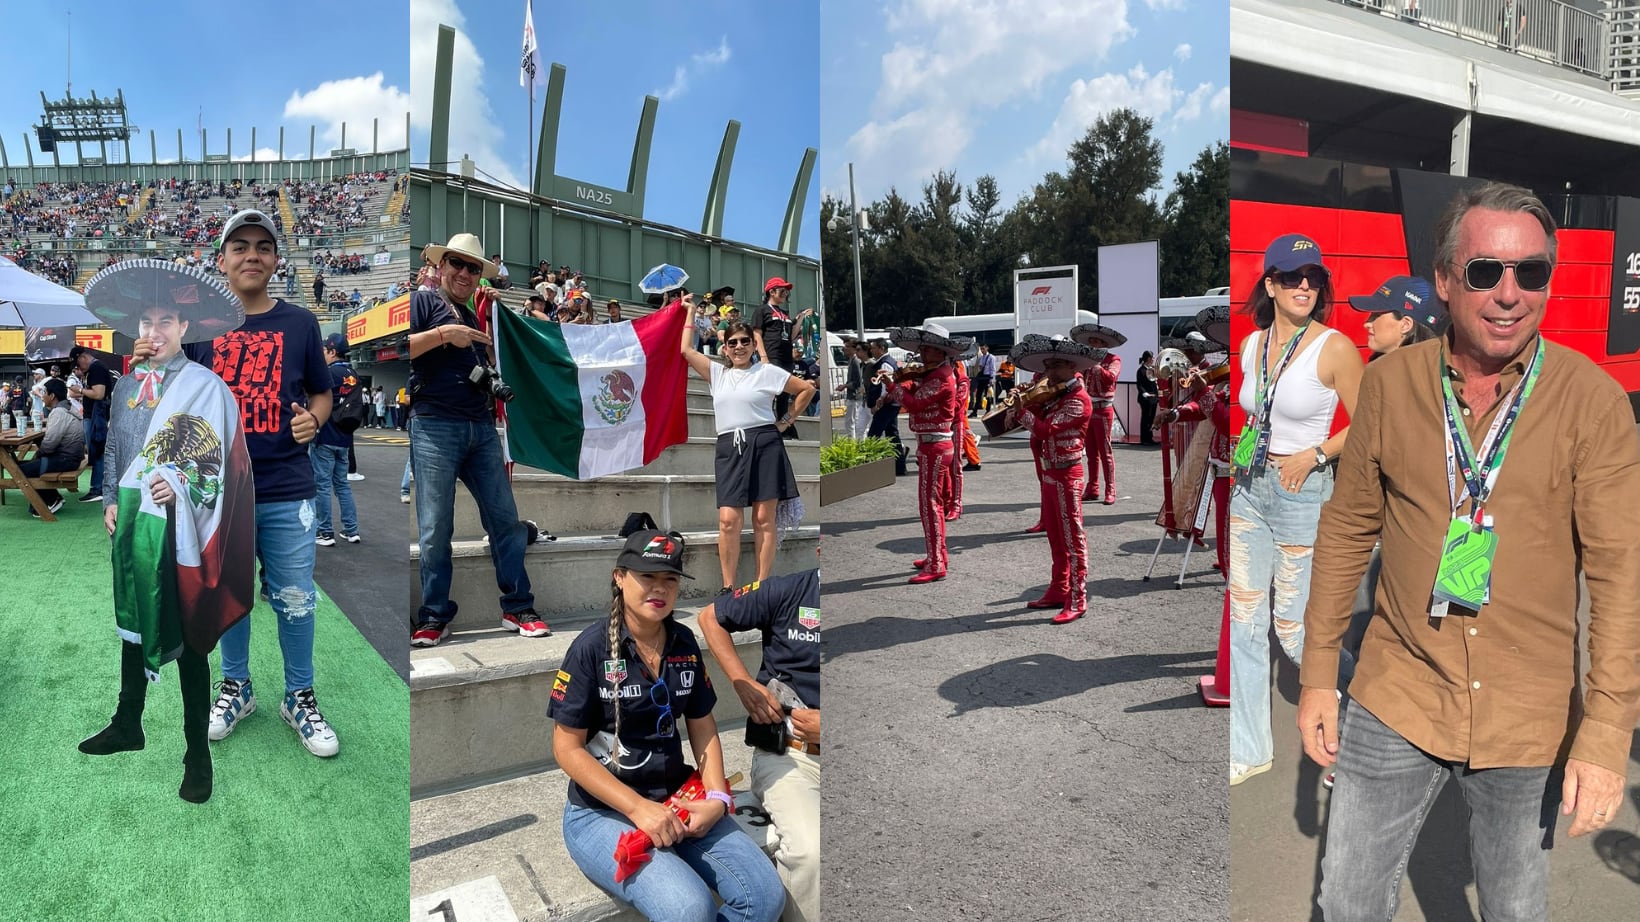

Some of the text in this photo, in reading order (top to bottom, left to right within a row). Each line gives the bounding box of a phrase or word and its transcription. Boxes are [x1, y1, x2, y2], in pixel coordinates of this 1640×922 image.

[576, 185, 613, 205] NA25
[1023, 296, 1064, 305] PADDOCK
[1623, 286, 1640, 309] 55
[788, 628, 820, 643] Mobil
